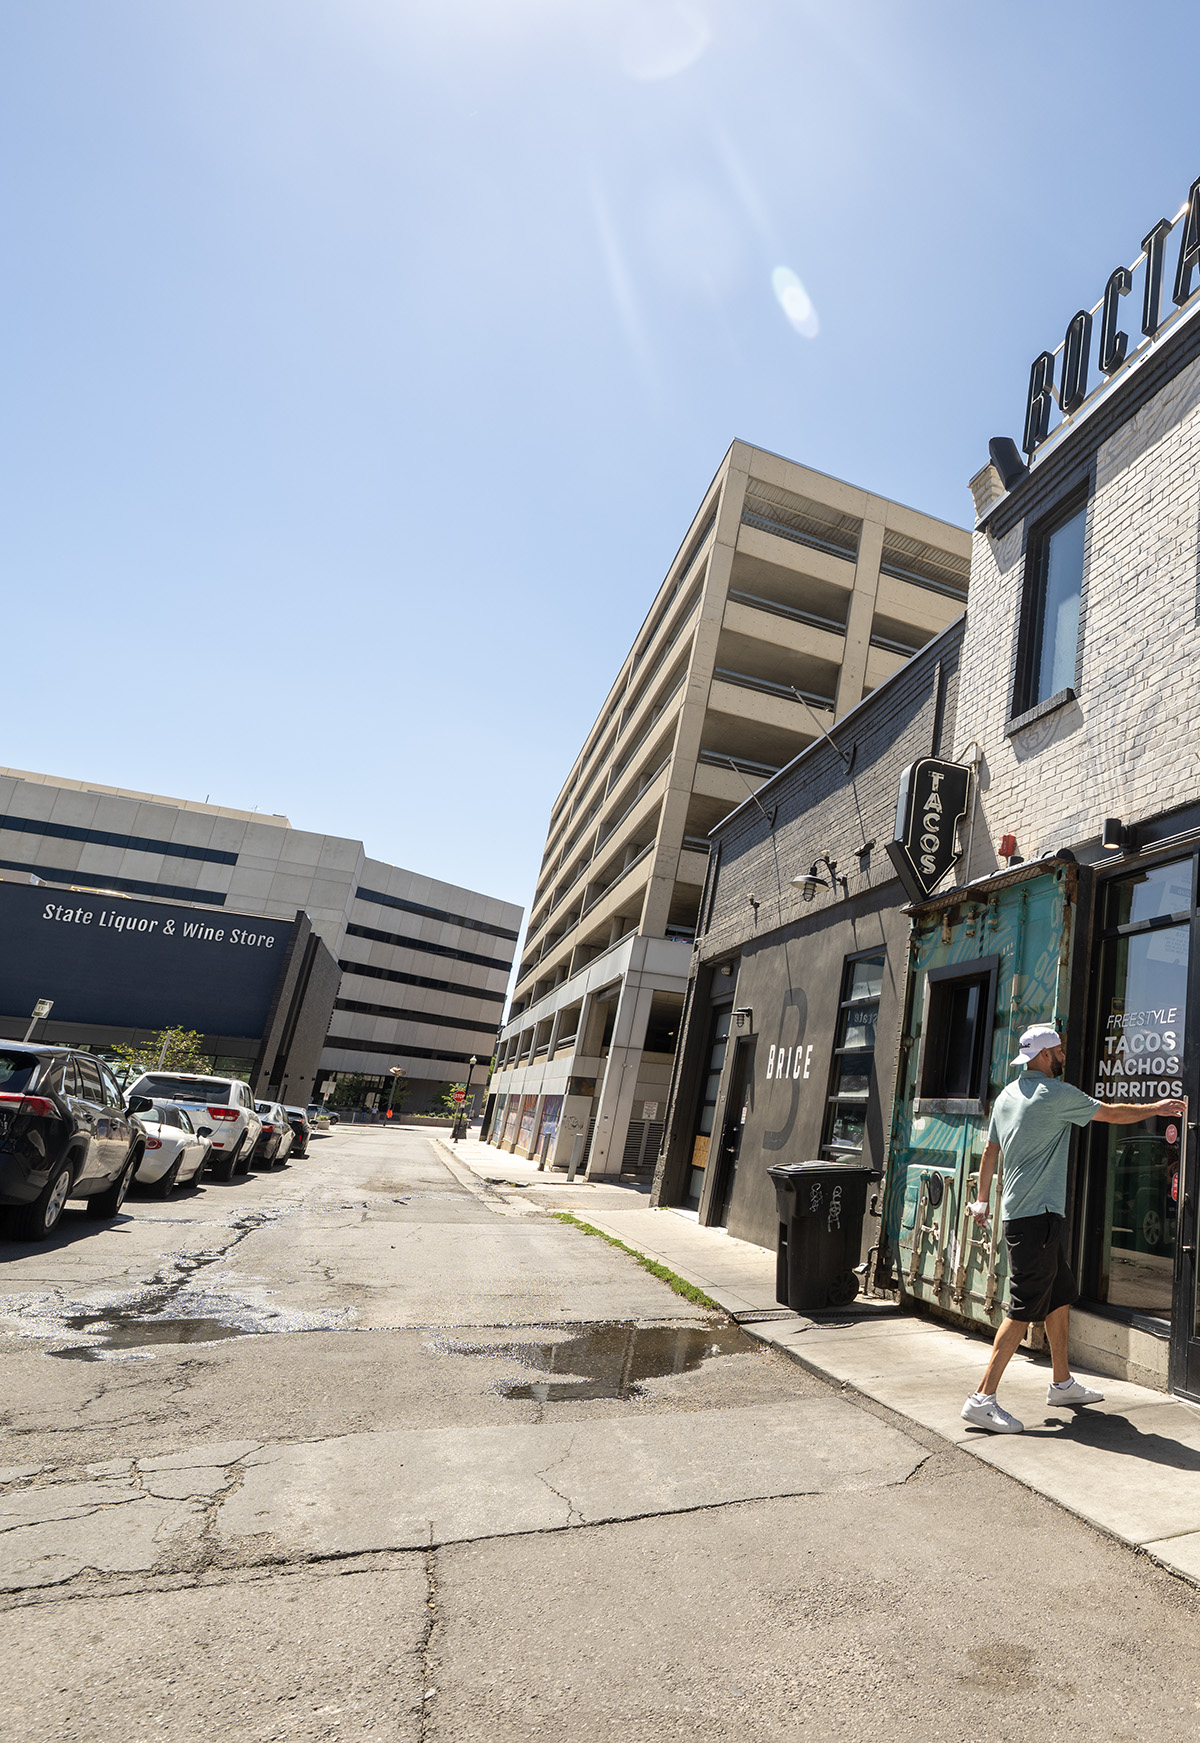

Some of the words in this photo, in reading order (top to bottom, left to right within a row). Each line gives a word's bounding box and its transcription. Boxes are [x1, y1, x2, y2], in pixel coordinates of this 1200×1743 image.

[919, 770, 945, 875] TACOS
[42, 903, 93, 924] State
[99, 911, 159, 933] Liquor
[162, 919, 176, 935] &
[182, 922, 225, 941] Wine
[229, 928, 275, 948] Store
[1106, 1007, 1178, 1029] FREESTYLE
[1104, 1031, 1177, 1055] TACOS
[766, 1044, 813, 1079] BRICE
[1098, 1056, 1179, 1076] NACHOS
[1094, 1080, 1183, 1098] BURRITOS
